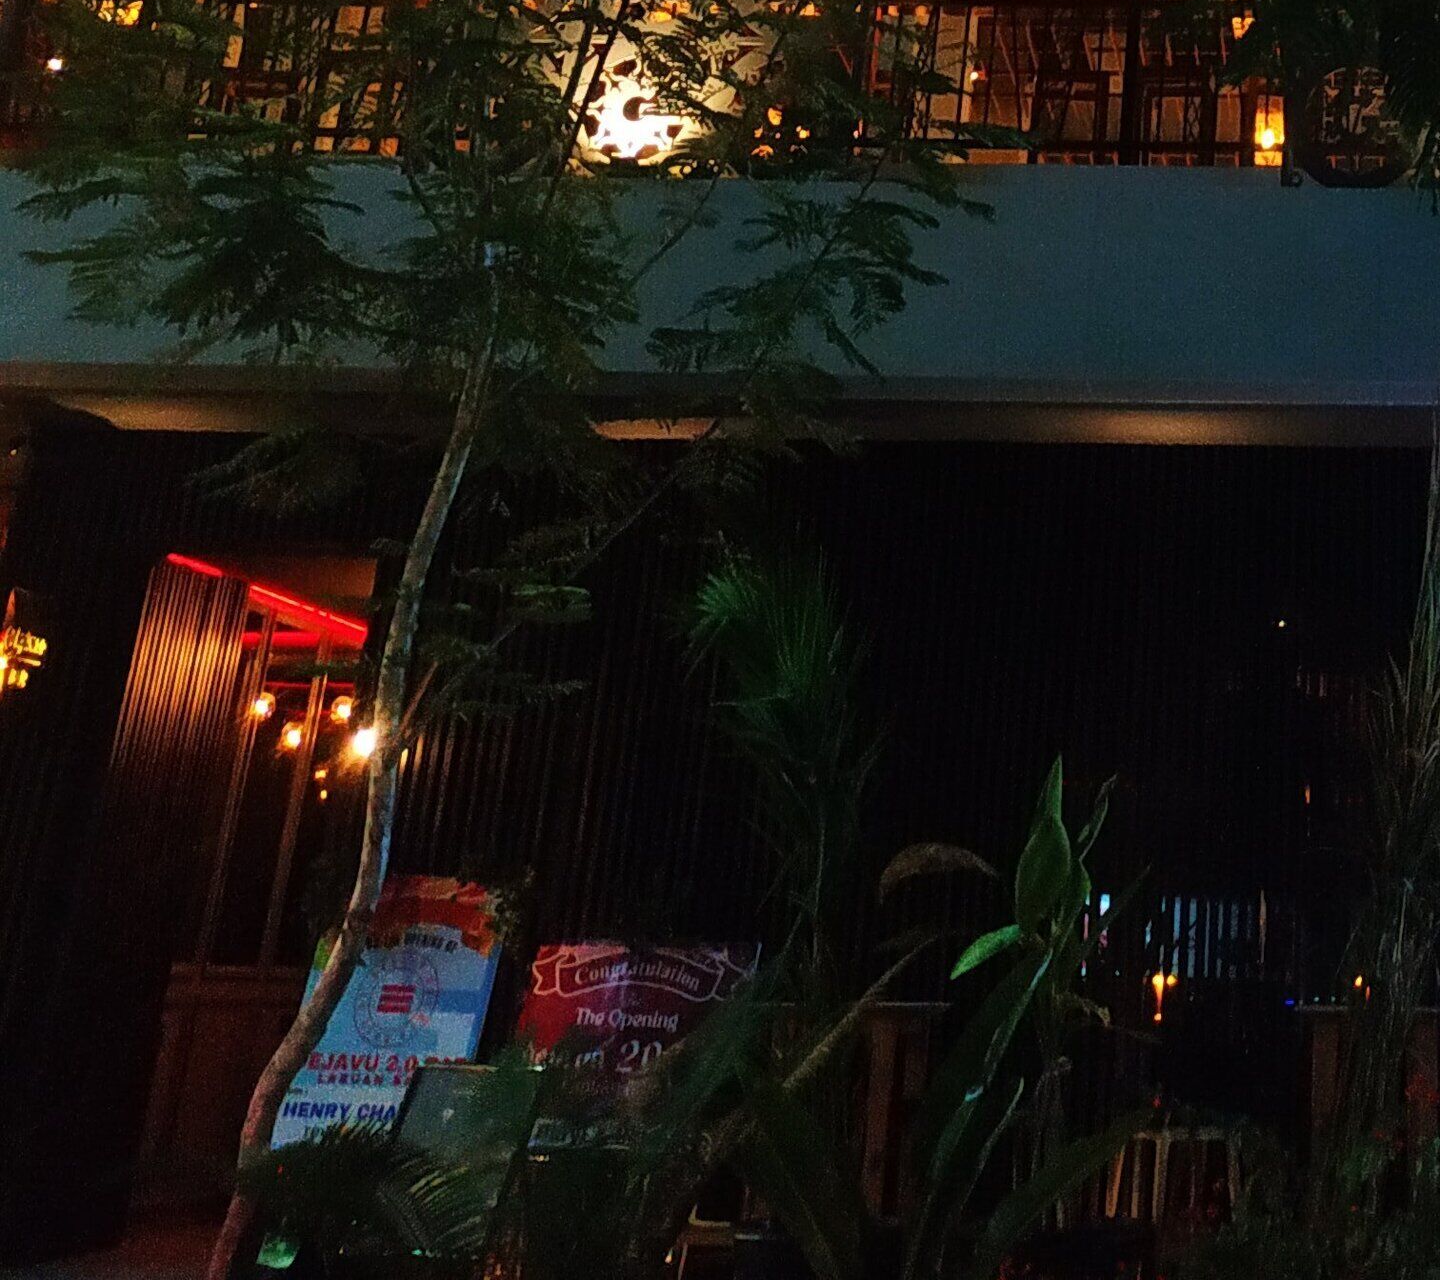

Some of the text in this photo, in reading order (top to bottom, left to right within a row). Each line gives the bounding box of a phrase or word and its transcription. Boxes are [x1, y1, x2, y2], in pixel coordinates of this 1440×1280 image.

[576, 1006, 680, 1034] The Opening
[307, 1052, 381, 1072] EJAVU
[283, 1102, 351, 1120] HENRY
